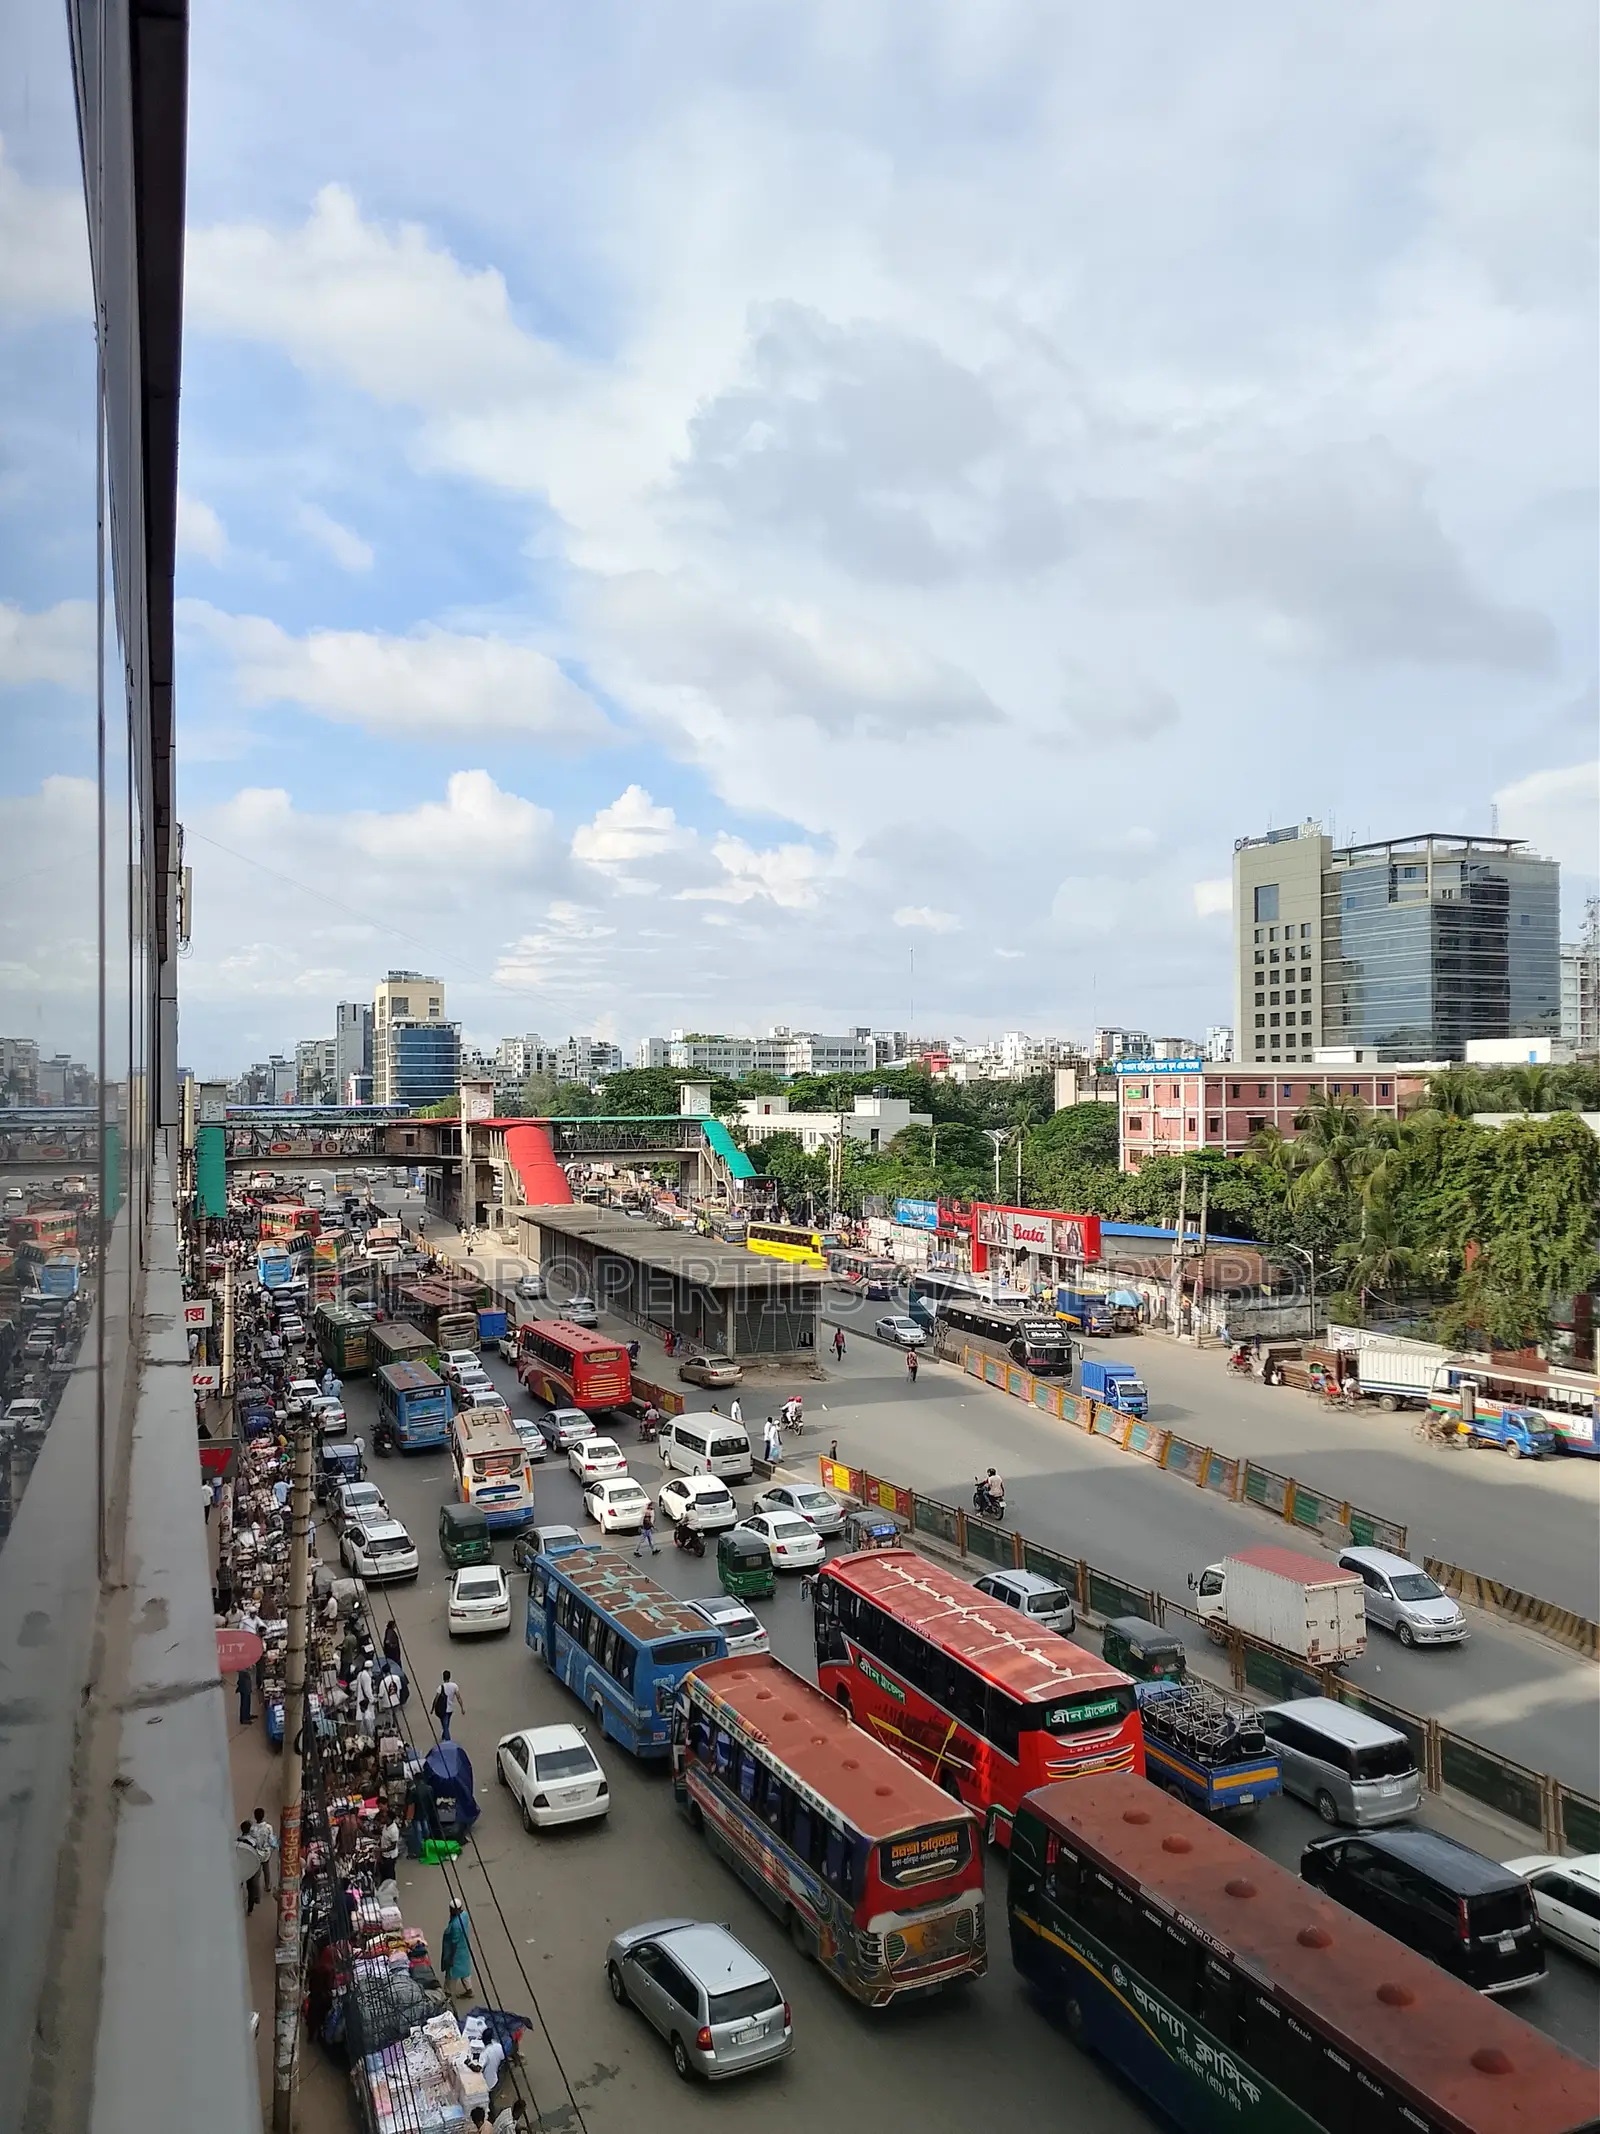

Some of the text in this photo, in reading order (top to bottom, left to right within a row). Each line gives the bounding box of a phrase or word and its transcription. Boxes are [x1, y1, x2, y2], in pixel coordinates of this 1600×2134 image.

[1013, 1222, 1046, 1243] Bata
[192, 1373, 214, 1386] ta
[1051, 1708, 1084, 1724] গ্রীন
[1202, 1933, 1231, 1958] CLASSIC
[1130, 1980, 1262, 2104] অনন্যা ক্লাসিক
[1176, 2046, 1205, 2080] পরিবহন
